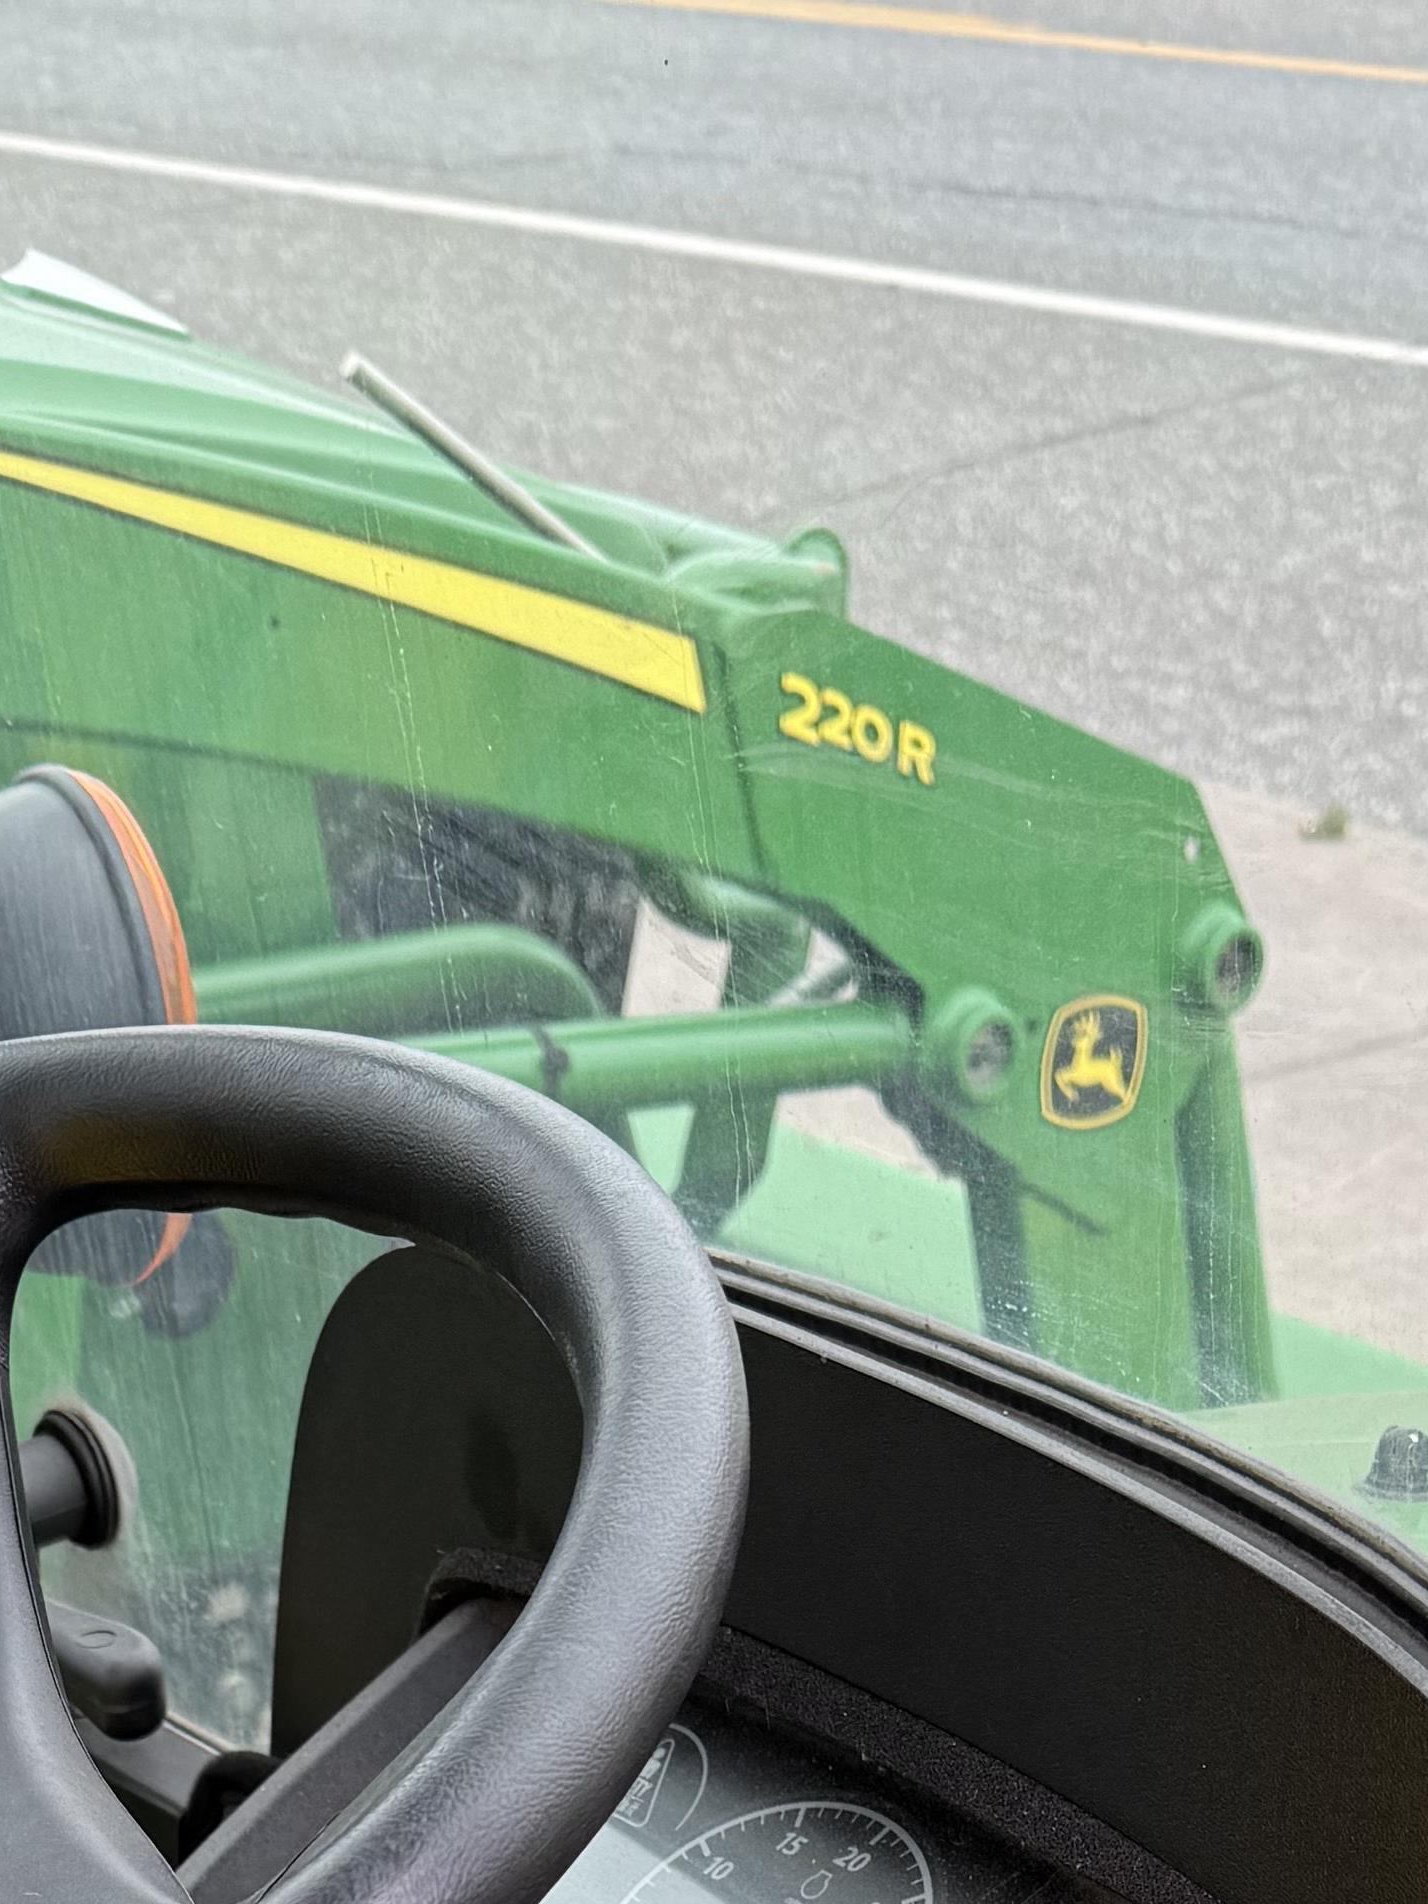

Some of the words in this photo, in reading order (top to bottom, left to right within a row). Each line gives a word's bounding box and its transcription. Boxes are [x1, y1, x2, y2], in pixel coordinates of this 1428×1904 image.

[775, 1832, 809, 1855] 15
[703, 1856, 734, 1880] 10
[832, 1846, 871, 1872] 20
